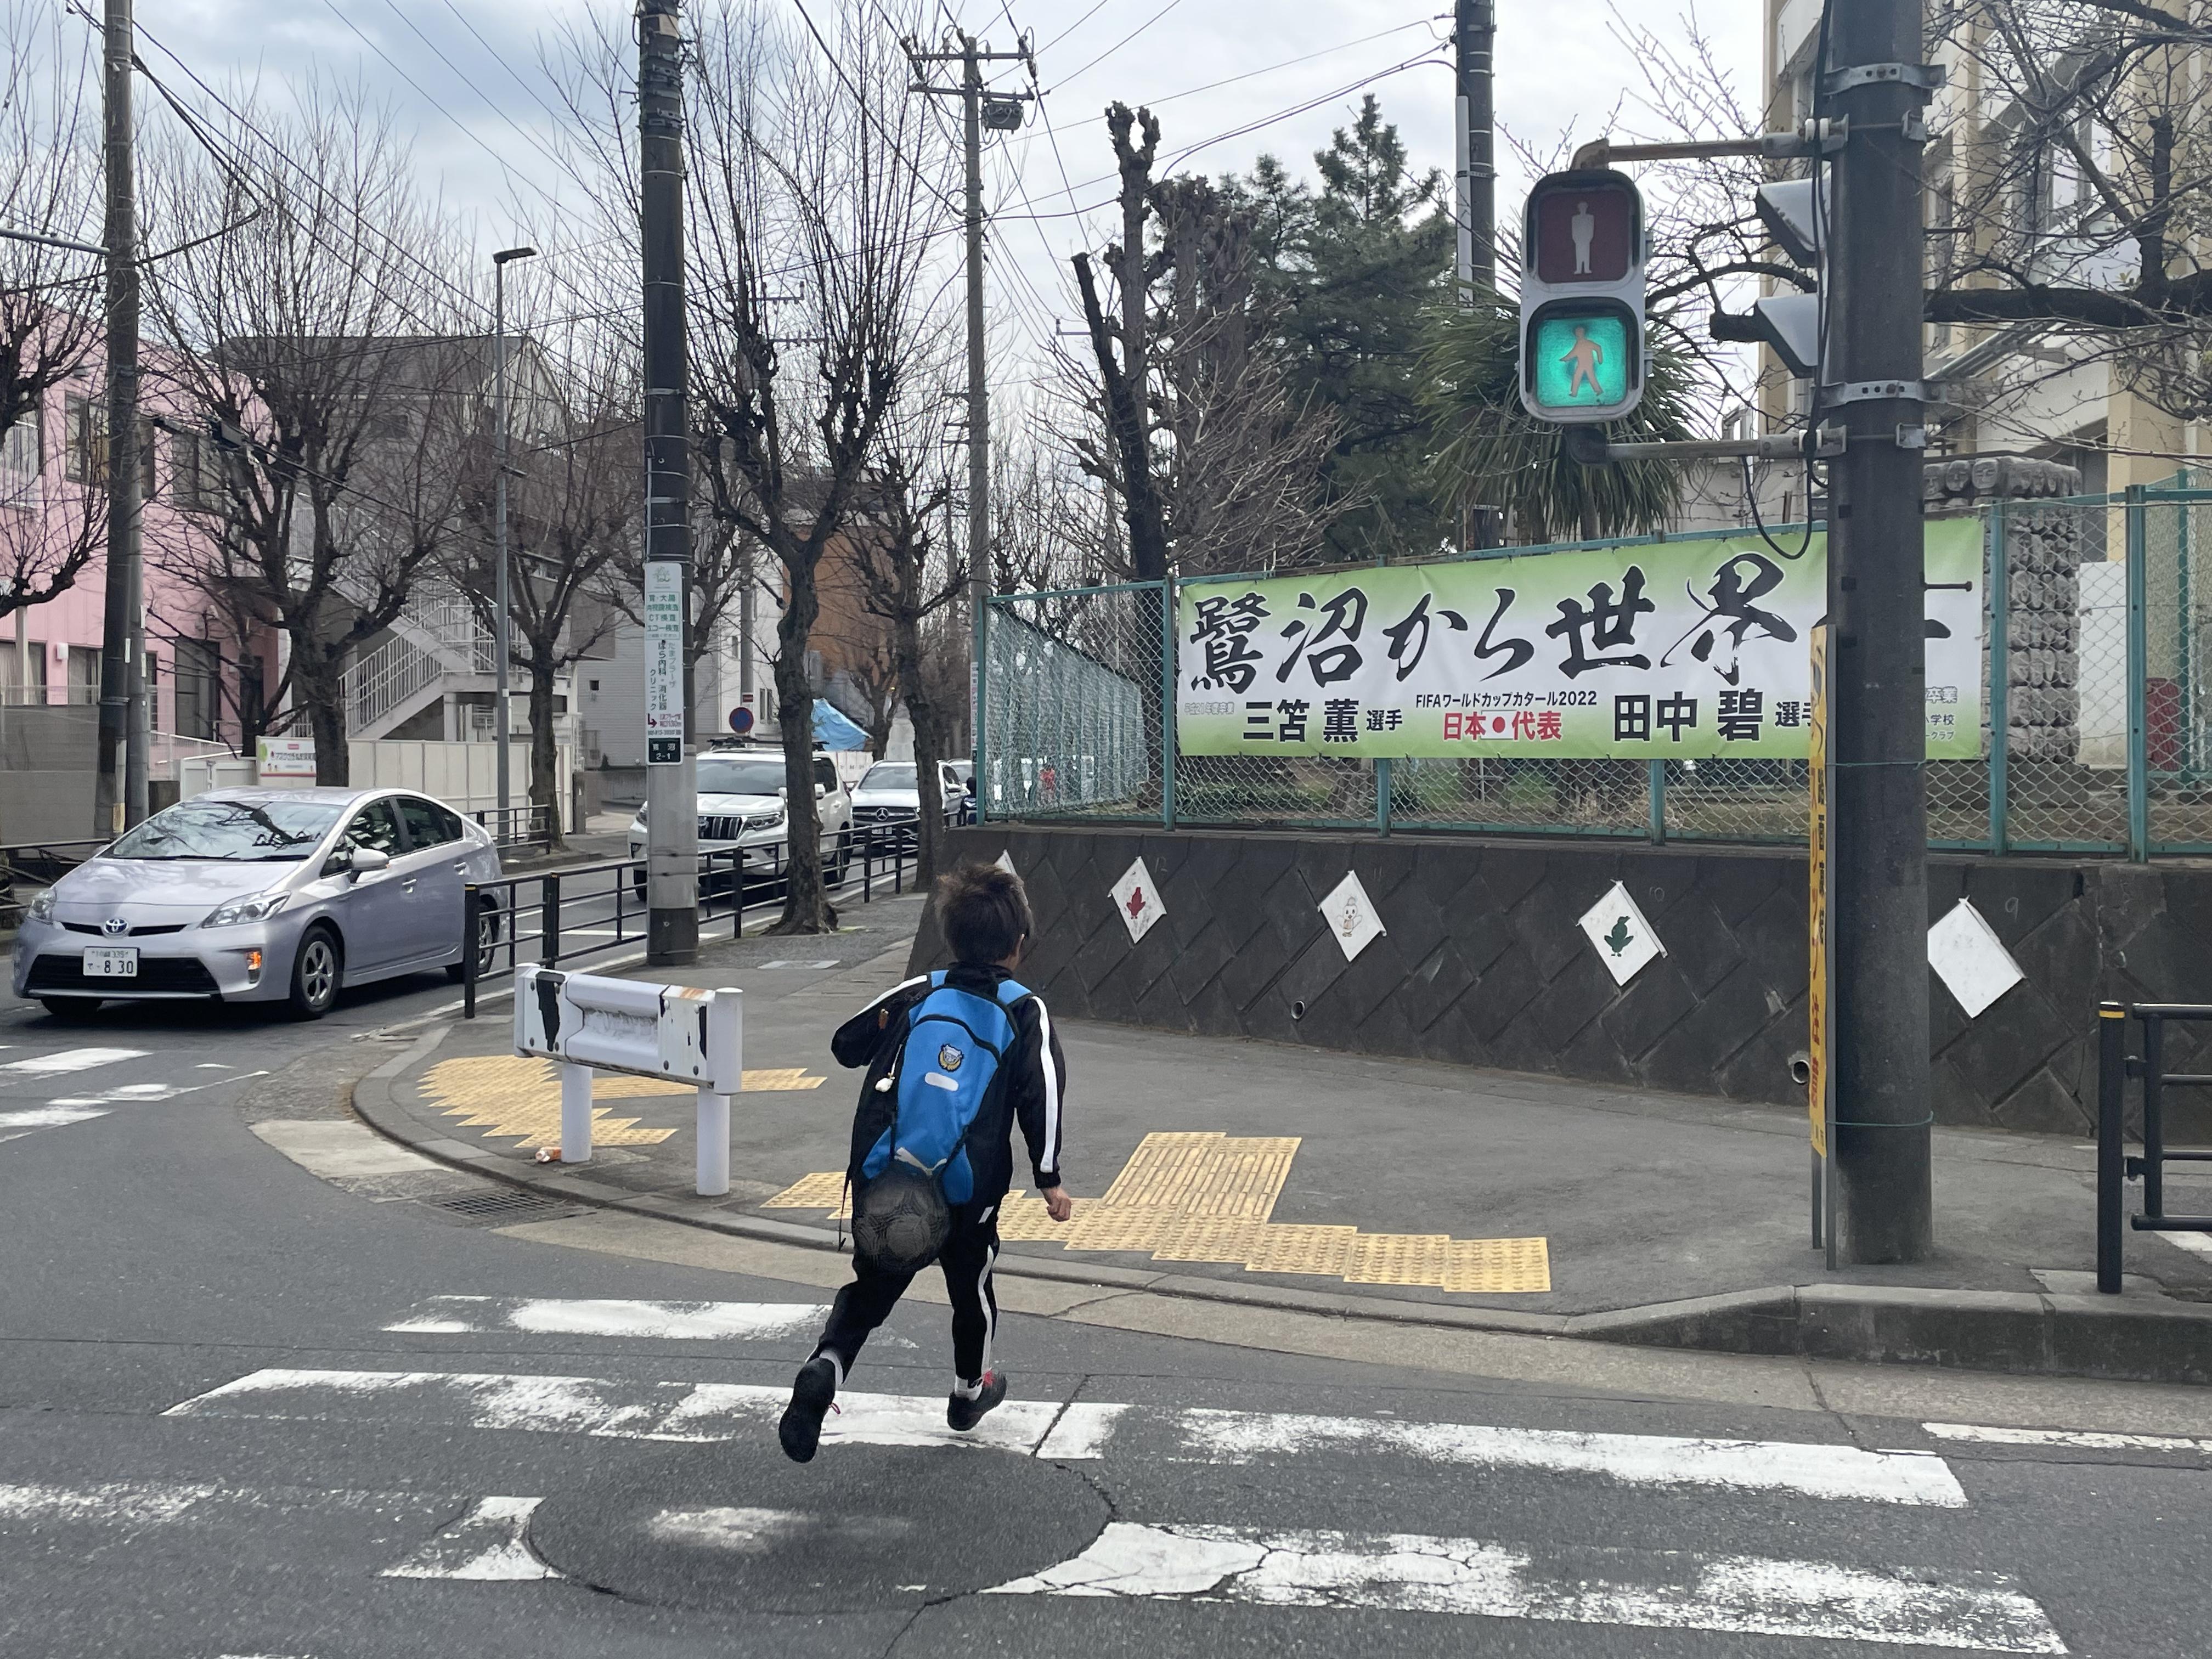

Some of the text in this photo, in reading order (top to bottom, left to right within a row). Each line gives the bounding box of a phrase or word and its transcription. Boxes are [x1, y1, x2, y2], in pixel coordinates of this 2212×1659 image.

[1189, 552, 1951, 694] 鷺沼から世界
[1366, 709, 1403, 731] 選手
[1443, 711, 1562, 741] 日本 代表
[1615, 691, 1698, 742] 田中
[1717, 688, 1764, 741] 碧
